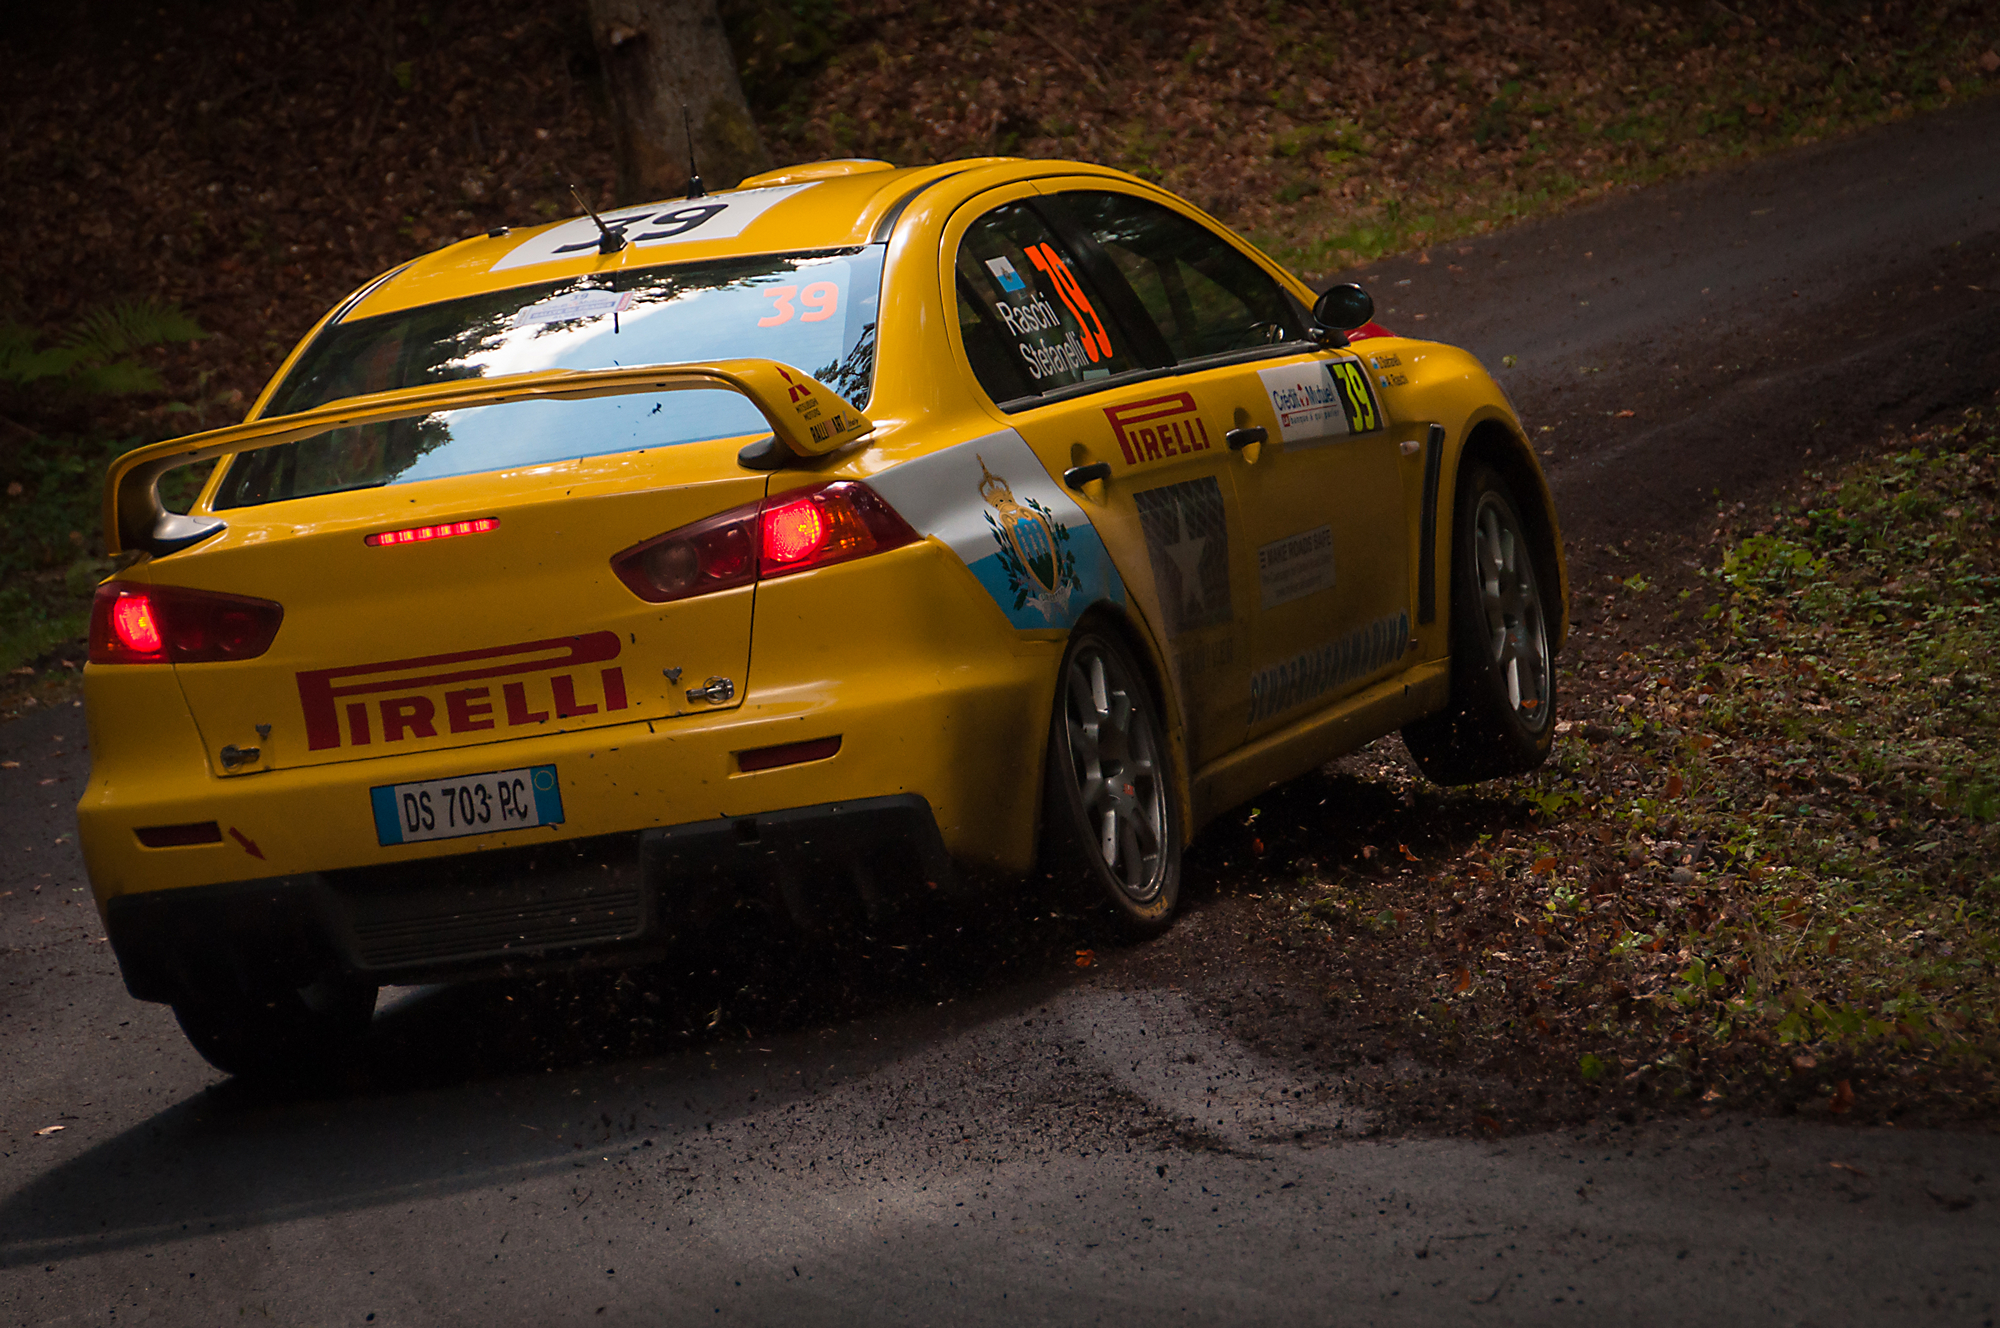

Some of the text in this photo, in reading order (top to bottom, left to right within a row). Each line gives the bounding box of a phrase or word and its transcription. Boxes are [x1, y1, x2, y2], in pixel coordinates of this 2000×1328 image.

[552, 204, 728, 253] 39
[758, 281, 838, 327] 39
[996, 292, 1060, 336] Raschi
[1023, 242, 1113, 363] 39
[1019, 331, 1089, 379] Stefanelli
[1273, 383, 1336, 411] Crédit Mutuel
[1332, 363, 1374, 432] 39
[1103, 391, 1210, 465] PIRELLI
[295, 630, 628, 751] PIRELLI
[403, 778, 529, 833] DS 703 PC
